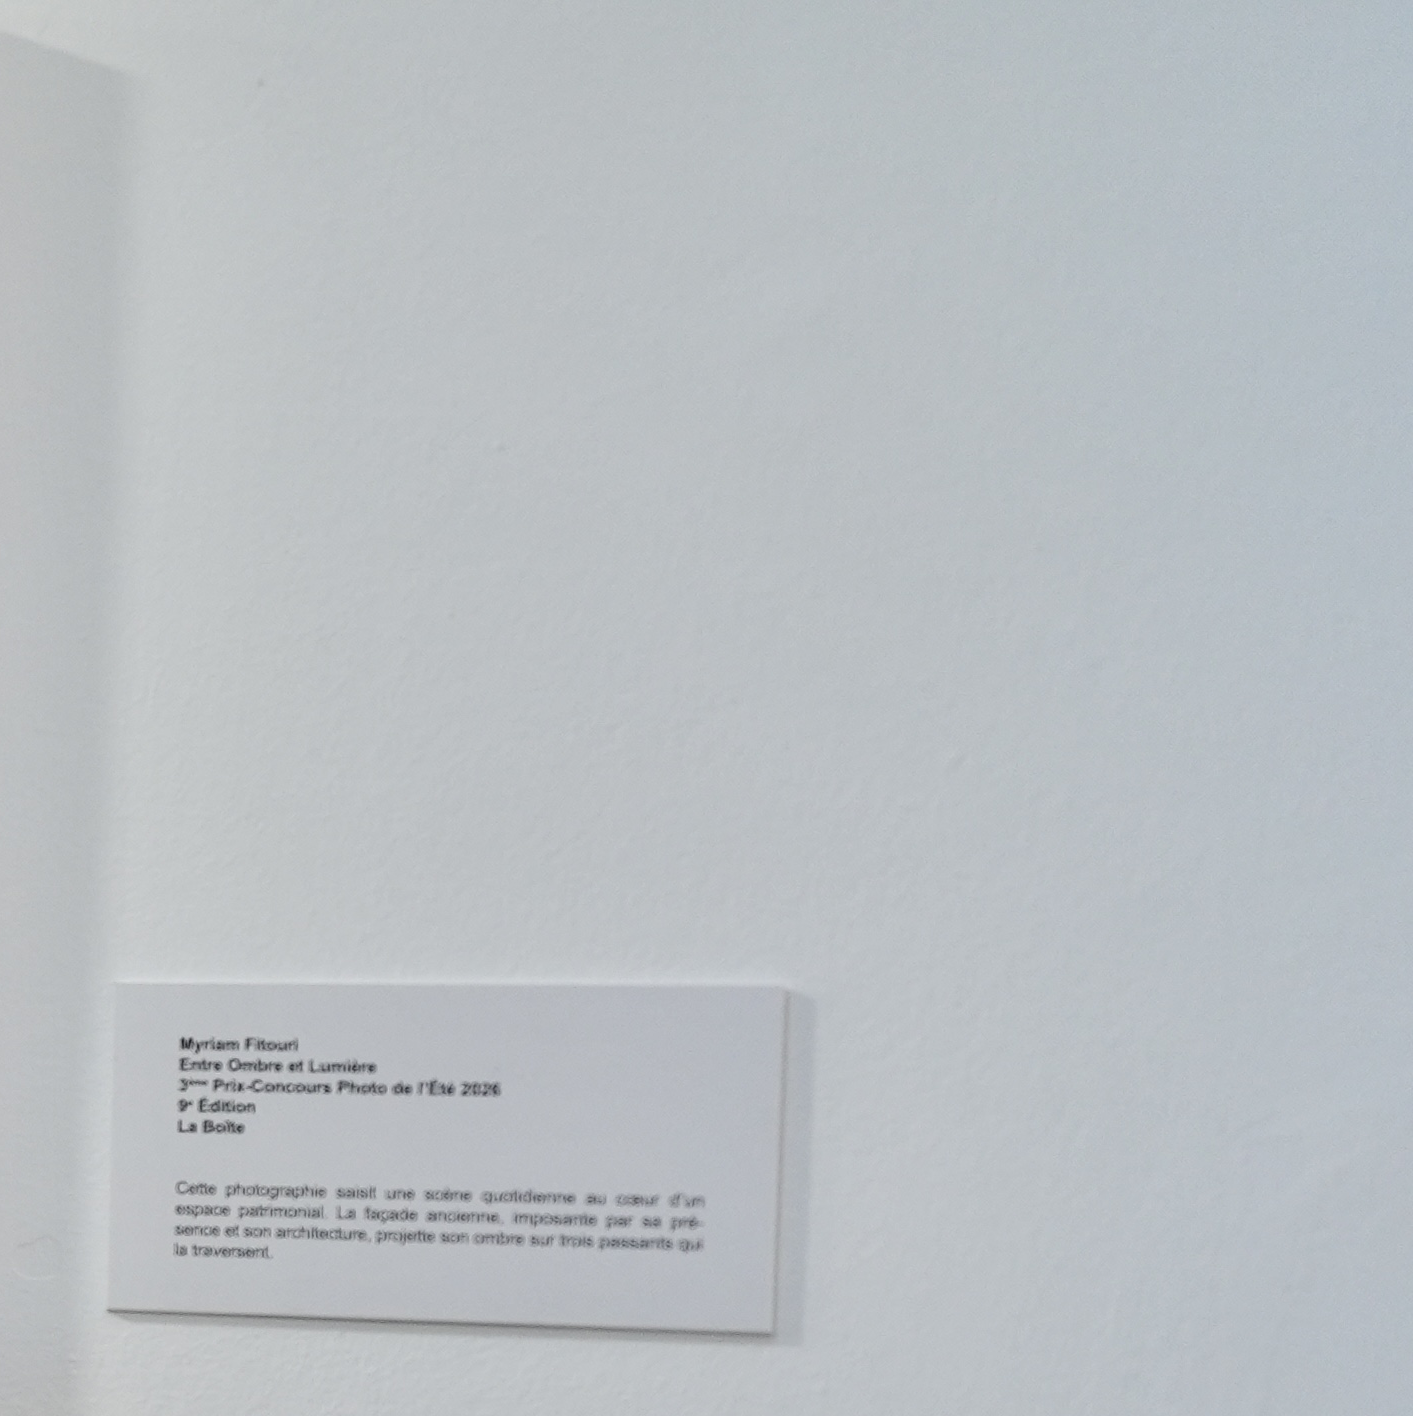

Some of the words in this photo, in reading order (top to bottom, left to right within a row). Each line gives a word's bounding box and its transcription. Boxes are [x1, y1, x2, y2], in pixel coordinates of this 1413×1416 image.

[178, 1037, 240, 1054] Myriam
[243, 1037, 298, 1052] Fitouri
[178, 1057, 223, 1072] Entre
[227, 1057, 283, 1073] Ombre
[287, 1060, 303, 1073] et
[307, 1060, 377, 1074] Lumière
[212, 1079, 332, 1095] Prix-Concours
[336, 1080, 388, 1095] Photo
[390, 1081, 413, 1096] de
[416, 1078, 456, 1096] l'Été
[197, 1098, 256, 1114] Édition
[176, 1119, 197, 1134] La
[201, 1119, 245, 1135] Boîte
